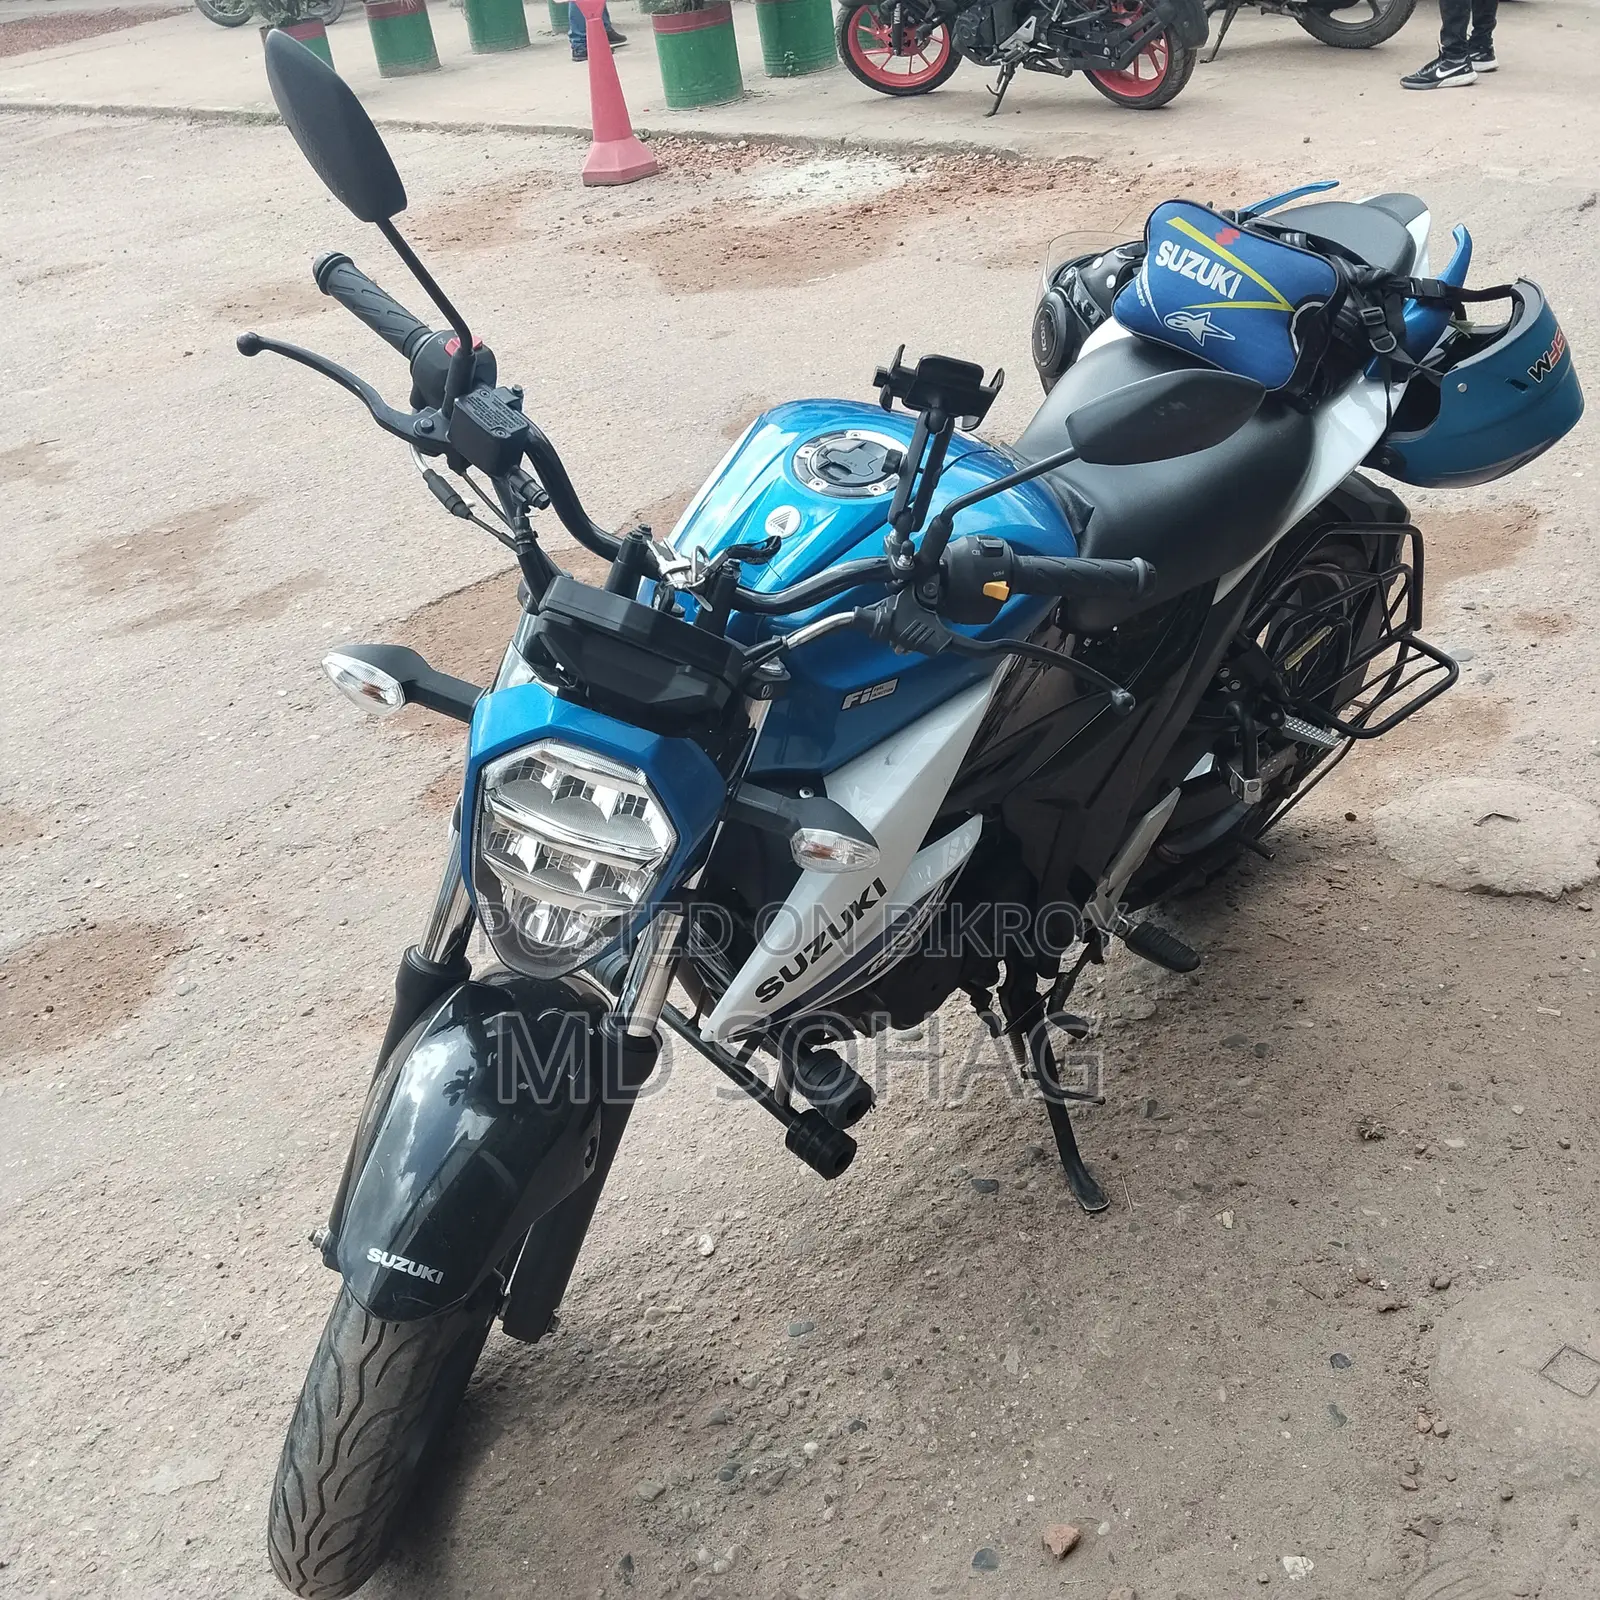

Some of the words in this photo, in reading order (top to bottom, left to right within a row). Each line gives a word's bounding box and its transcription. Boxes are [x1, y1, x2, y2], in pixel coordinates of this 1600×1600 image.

[1155, 240, 1243, 299] SUZUKI
[842, 687, 873, 710] Fi
[755, 877, 888, 1003] SUZUKI
[367, 1247, 445, 1285] SUZUKI
